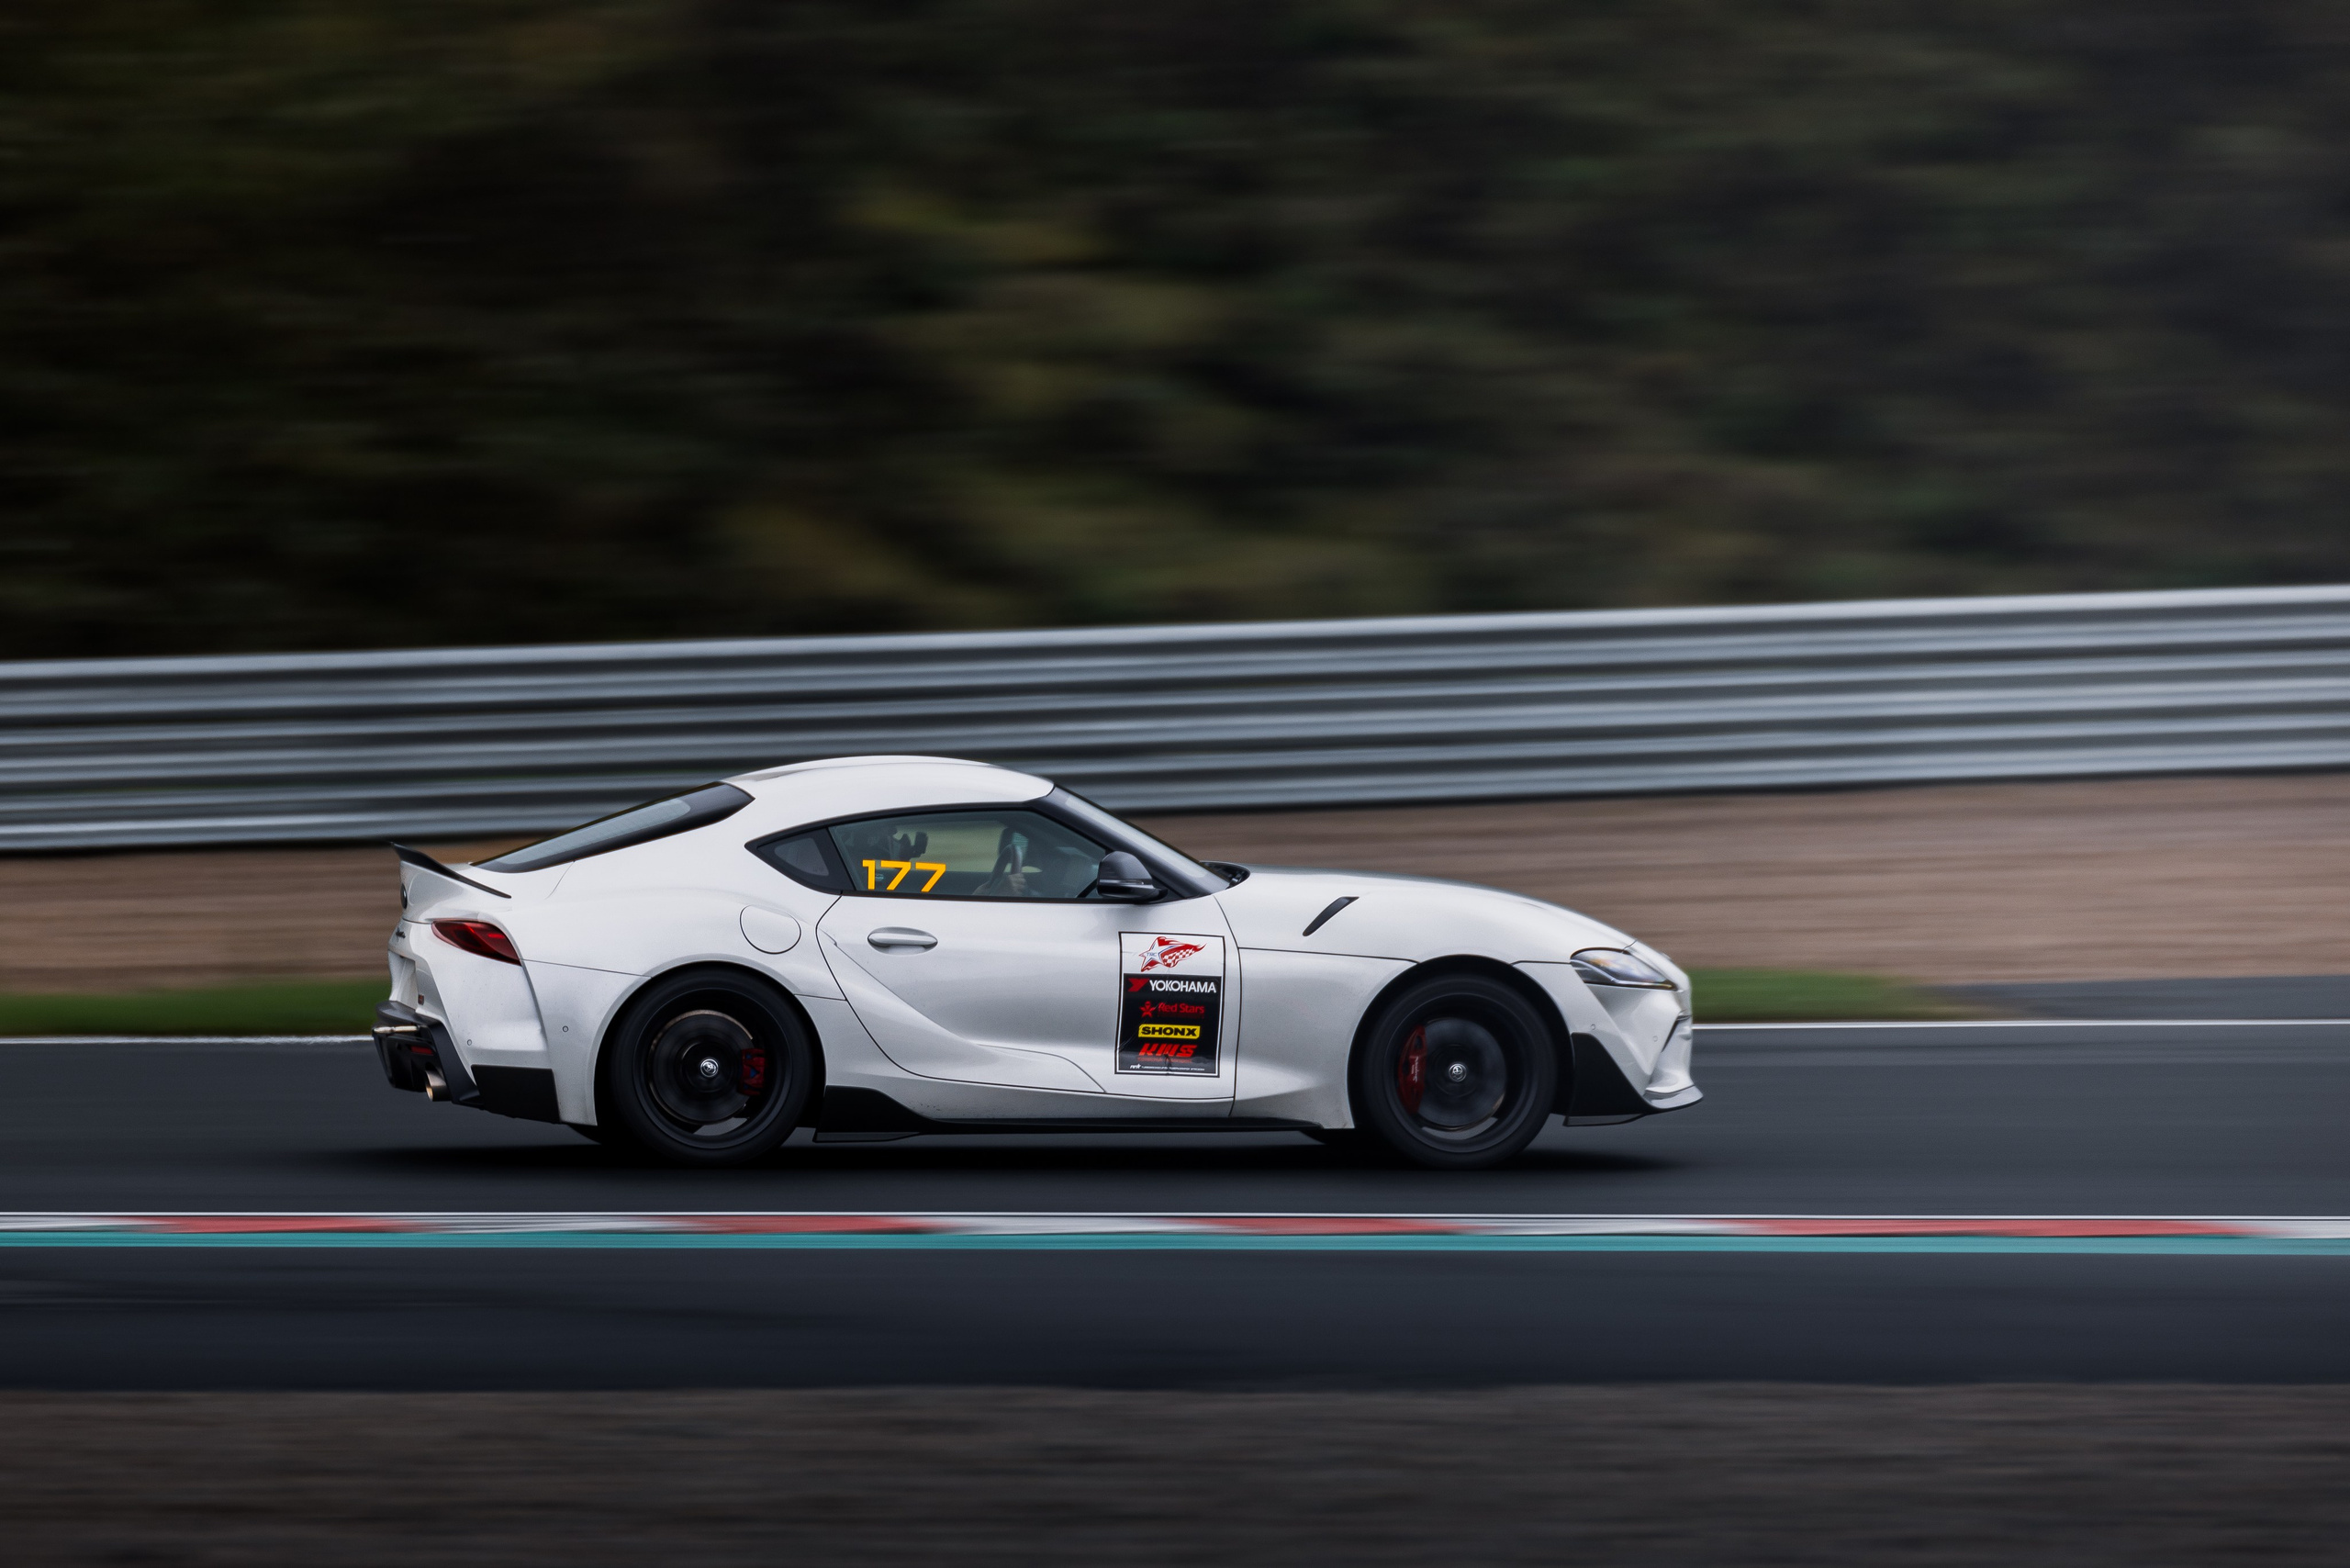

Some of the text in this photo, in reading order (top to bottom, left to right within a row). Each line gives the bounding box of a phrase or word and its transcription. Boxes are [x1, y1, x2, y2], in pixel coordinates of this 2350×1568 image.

[862, 859, 946, 892] 177
[1149, 980, 1217, 993] YOKOHAMA
[1158, 1002, 1205, 1014] Red Stars
[1141, 1026, 1197, 1036] SHONX
